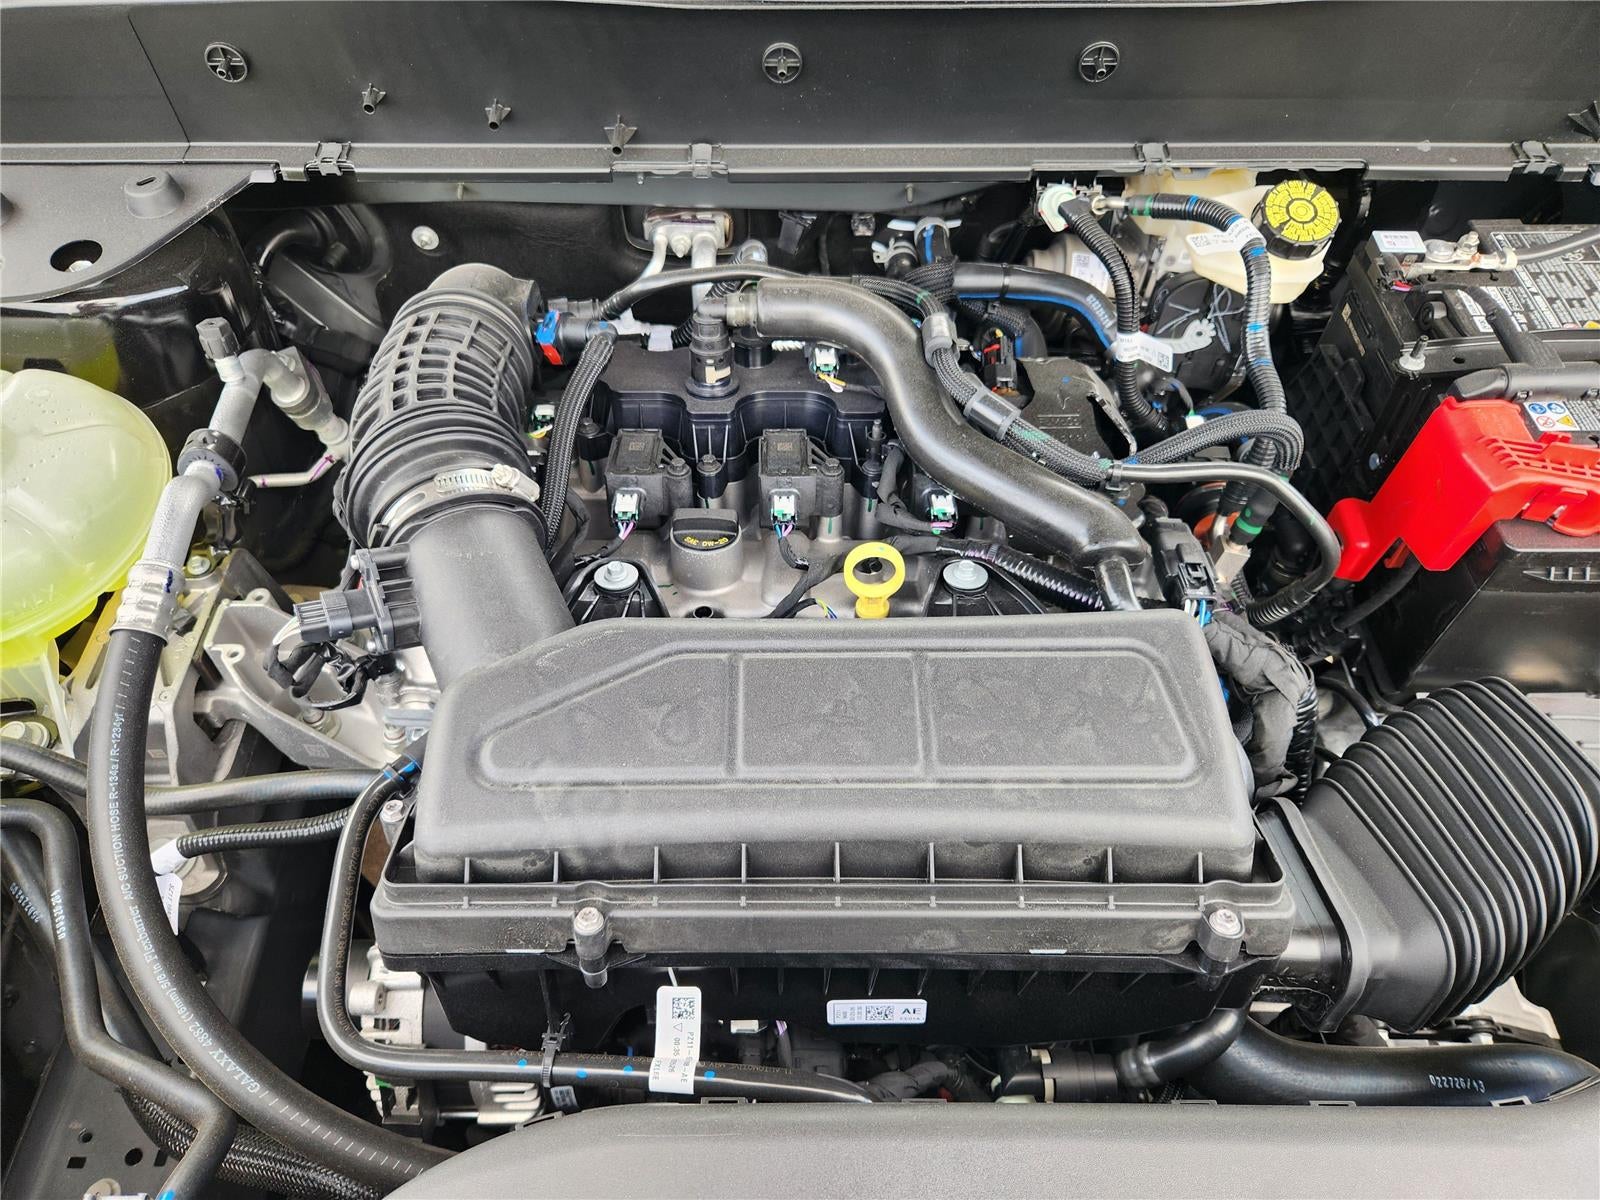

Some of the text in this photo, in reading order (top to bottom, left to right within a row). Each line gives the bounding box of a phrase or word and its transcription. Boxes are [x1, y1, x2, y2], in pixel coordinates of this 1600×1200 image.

[684, 536, 729, 547] SAE 0W-20
[110, 712, 125, 756] R-1234yf
[109, 762, 120, 799] R-134a
[109, 801, 121, 830] HOSE
[111, 830, 129, 881] SUCTION
[120, 883, 134, 901] A/C
[130, 904, 157, 964] Flexbarrier
[157, 973, 171, 988] 5/8
[166, 987, 194, 1023] (16mm)
[189, 1021, 213, 1047] 4882
[209, 1048, 260, 1093] GALAXY
